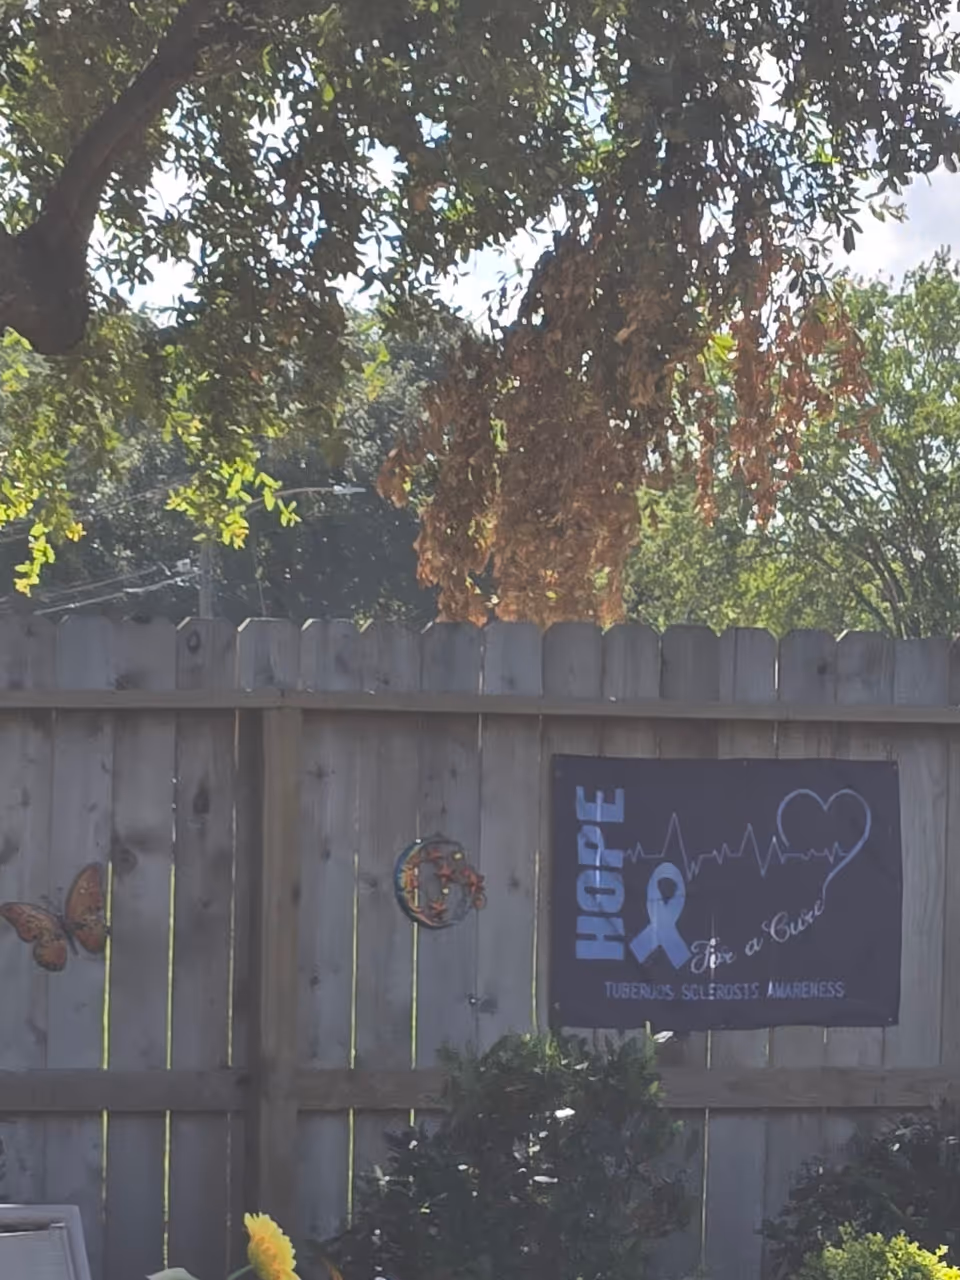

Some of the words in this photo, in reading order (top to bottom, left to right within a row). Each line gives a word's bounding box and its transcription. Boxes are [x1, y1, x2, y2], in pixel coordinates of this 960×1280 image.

[575, 785, 625, 961] HOPE
[744, 937, 764, 956] a
[761, 900, 824, 943] Cure
[604, 981, 674, 1000] TUBEROUS
[681, 982, 760, 1001] SCLEROSIS
[766, 979, 845, 999] AWARENESS
